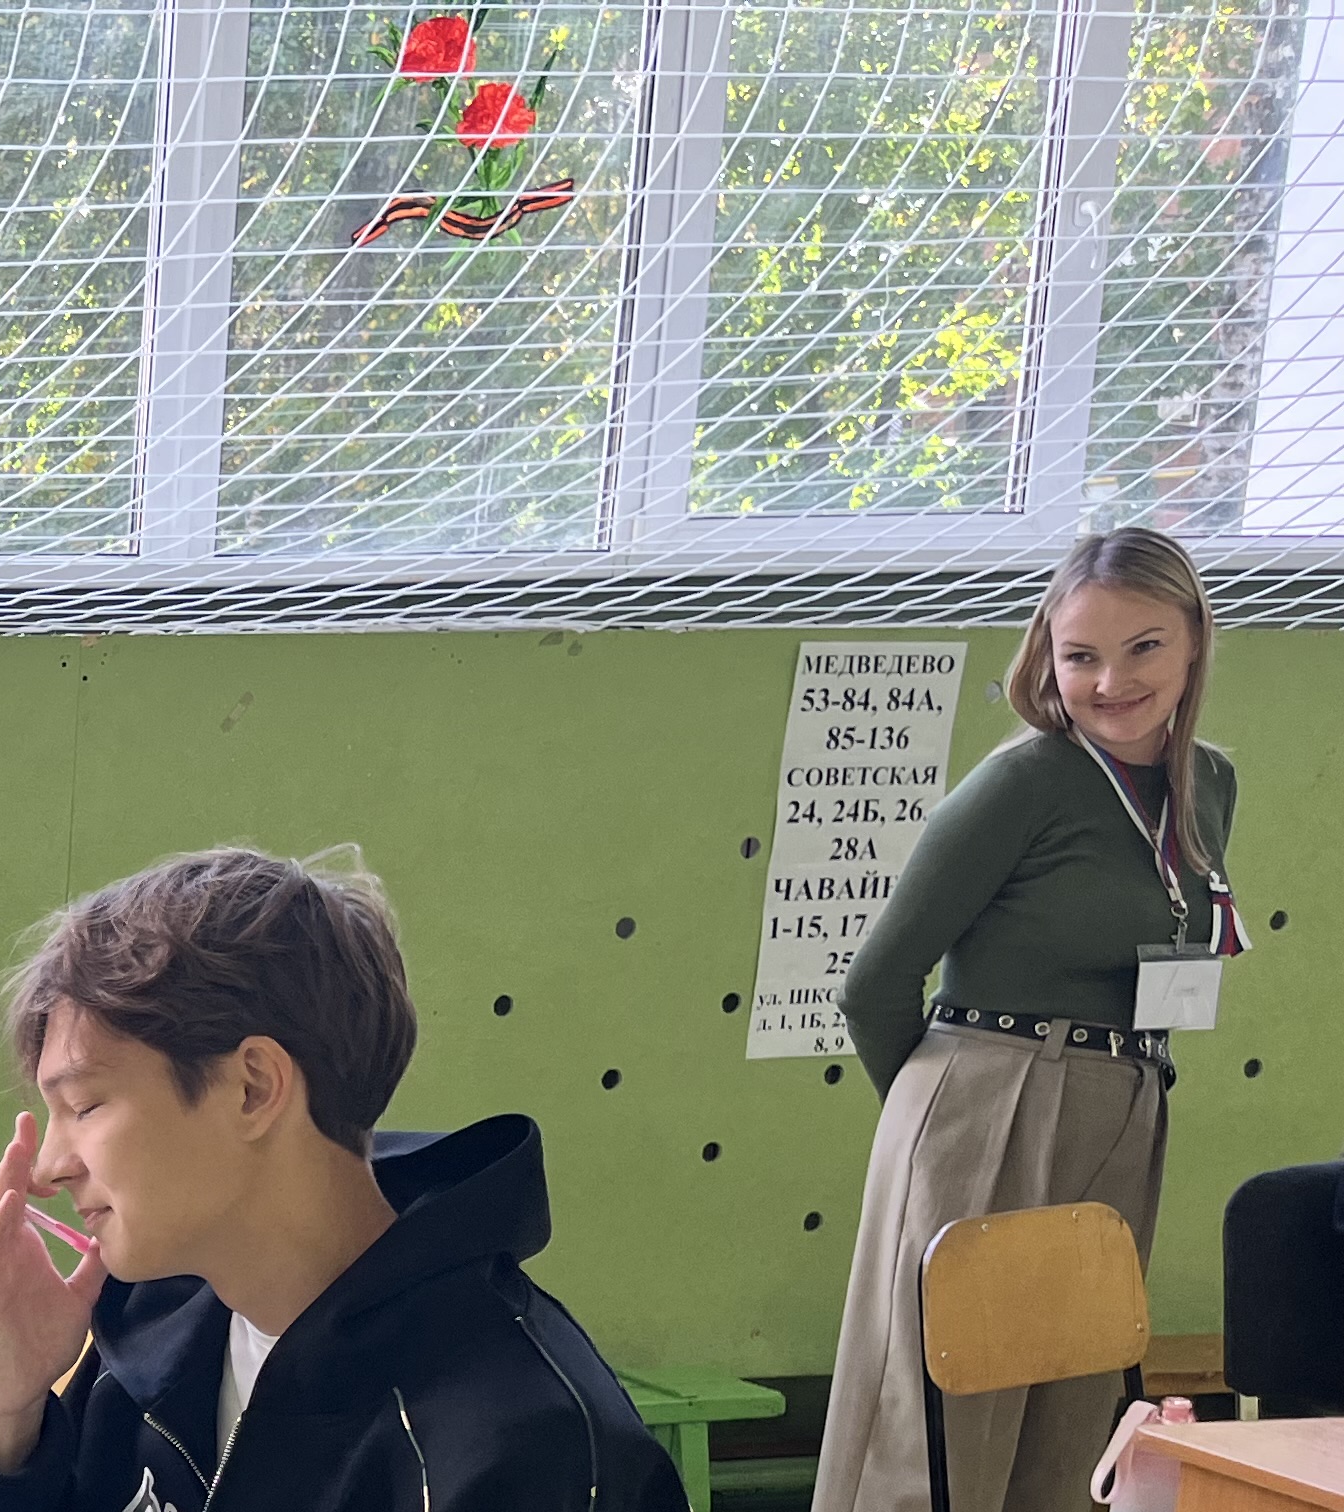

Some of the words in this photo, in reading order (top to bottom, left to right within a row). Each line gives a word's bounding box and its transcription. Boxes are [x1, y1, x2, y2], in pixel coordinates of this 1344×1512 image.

[802, 654, 955, 677] МЕДВЕДЕВО
[800, 687, 878, 713] 53-84,
[886, 687, 943, 715] 84А,
[825, 725, 910, 751] 85-136
[786, 765, 938, 787] СОВЕТСКАЯ
[786, 799, 823, 826] 24,
[831, 798, 886, 825] 24Б,
[828, 837, 877, 861] 28А
[770, 915, 829, 940] 1-15,
[756, 993, 783, 1011] ул.
[780, 1014, 793, 1031] 1,
[800, 1012, 826, 1030] 1Б,
[813, 1037, 829, 1054] 8,
[834, 1036, 845, 1050] 9
